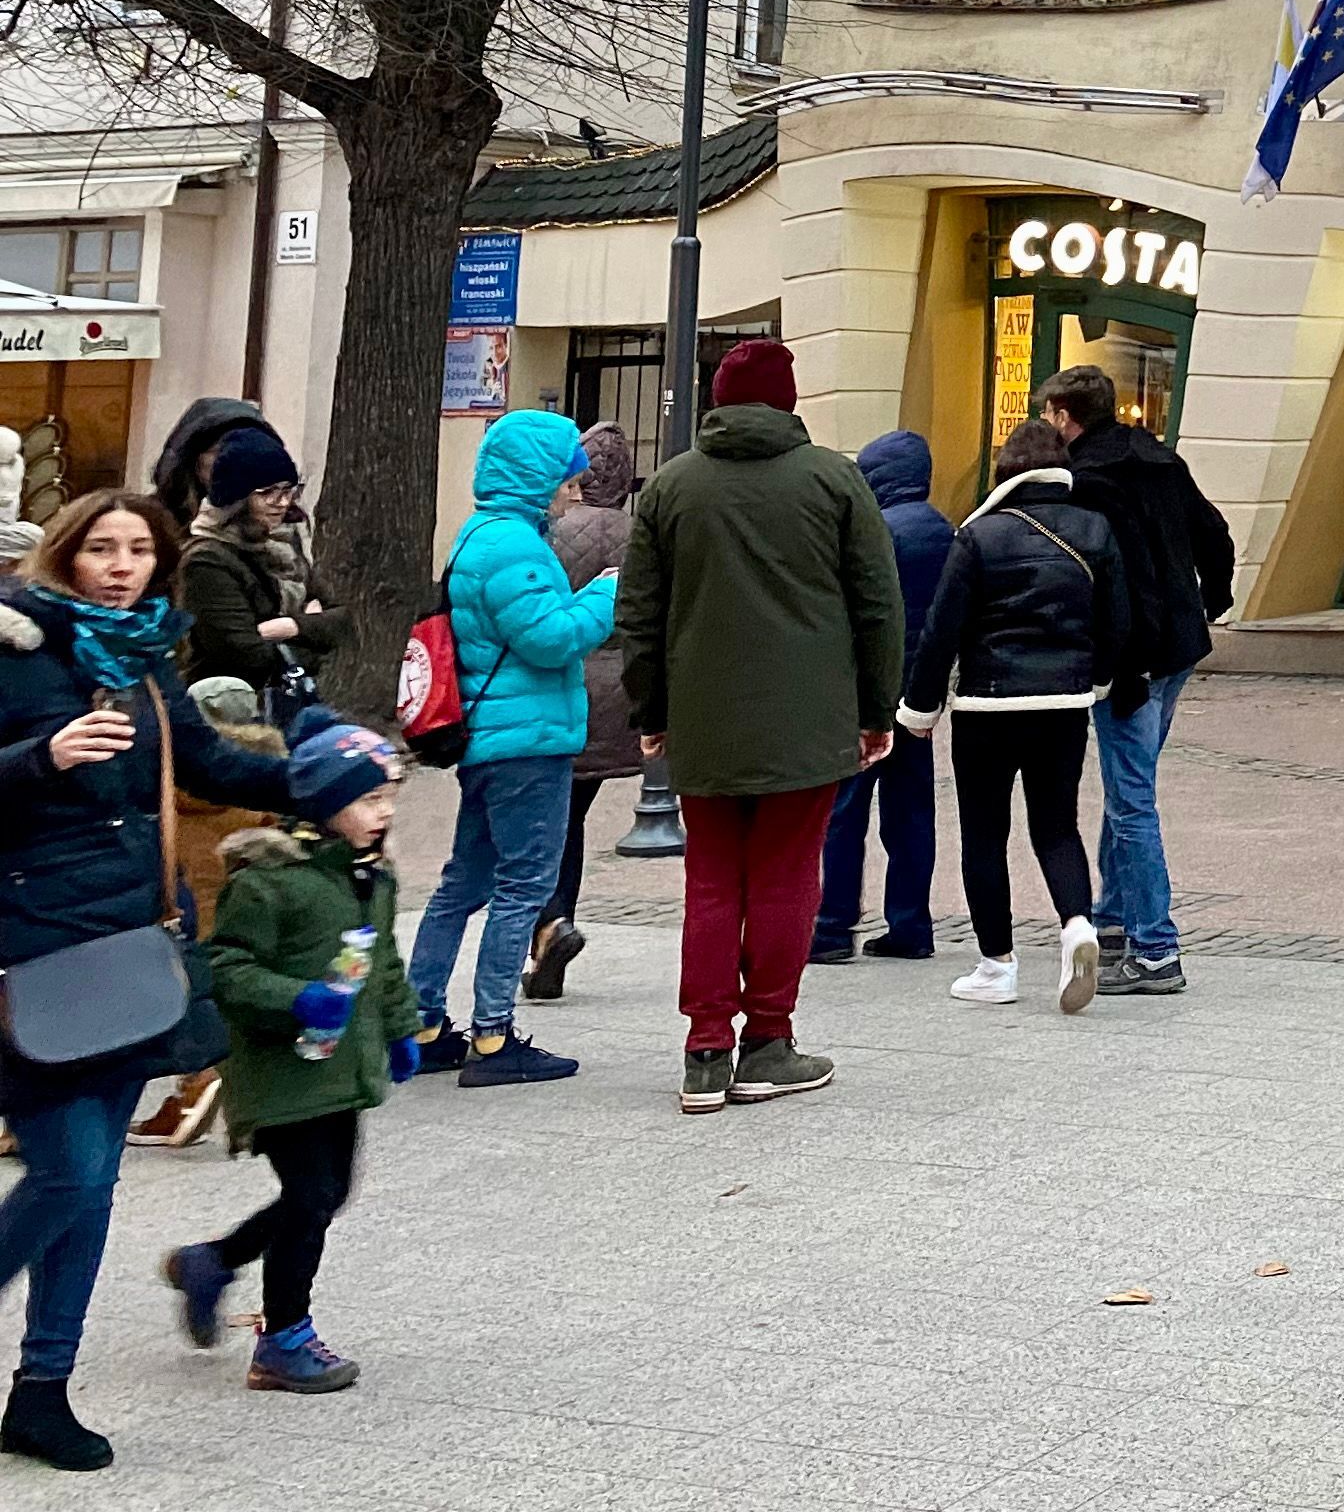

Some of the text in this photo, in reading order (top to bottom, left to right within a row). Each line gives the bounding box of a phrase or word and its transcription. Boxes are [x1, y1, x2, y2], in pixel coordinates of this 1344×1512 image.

[288, 216, 308, 240] 51
[1009, 220, 1199, 296] COSTA
[460, 287, 505, 299] francuski
[0, 328, 44, 351] udel
